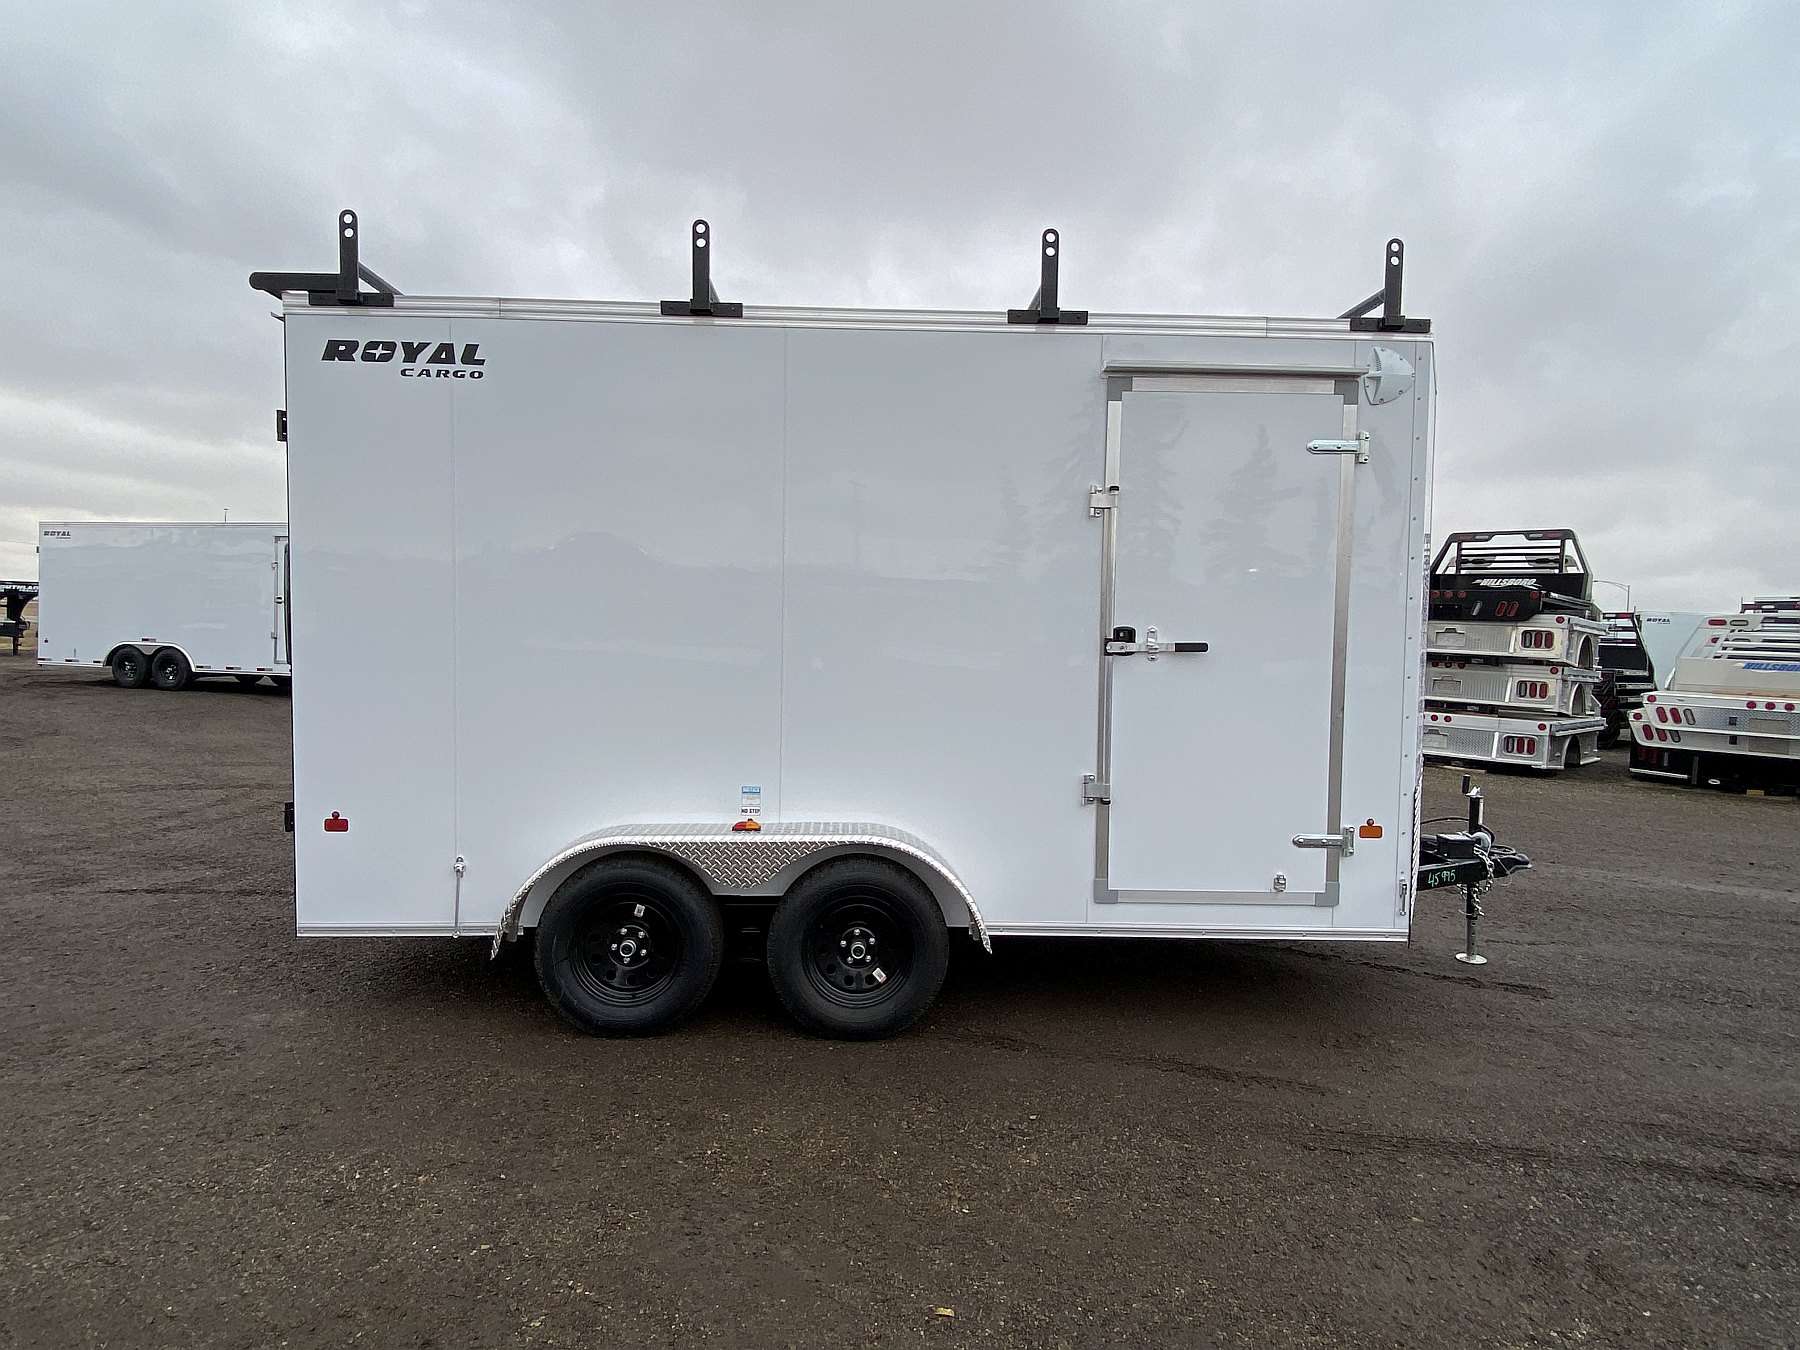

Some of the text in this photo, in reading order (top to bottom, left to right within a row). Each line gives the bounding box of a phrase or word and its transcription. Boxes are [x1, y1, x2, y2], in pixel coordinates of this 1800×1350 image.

[321, 339, 486, 366] ROYAL
[400, 368, 485, 379] CARGO
[1479, 577, 1538, 587] HILLSBORO
